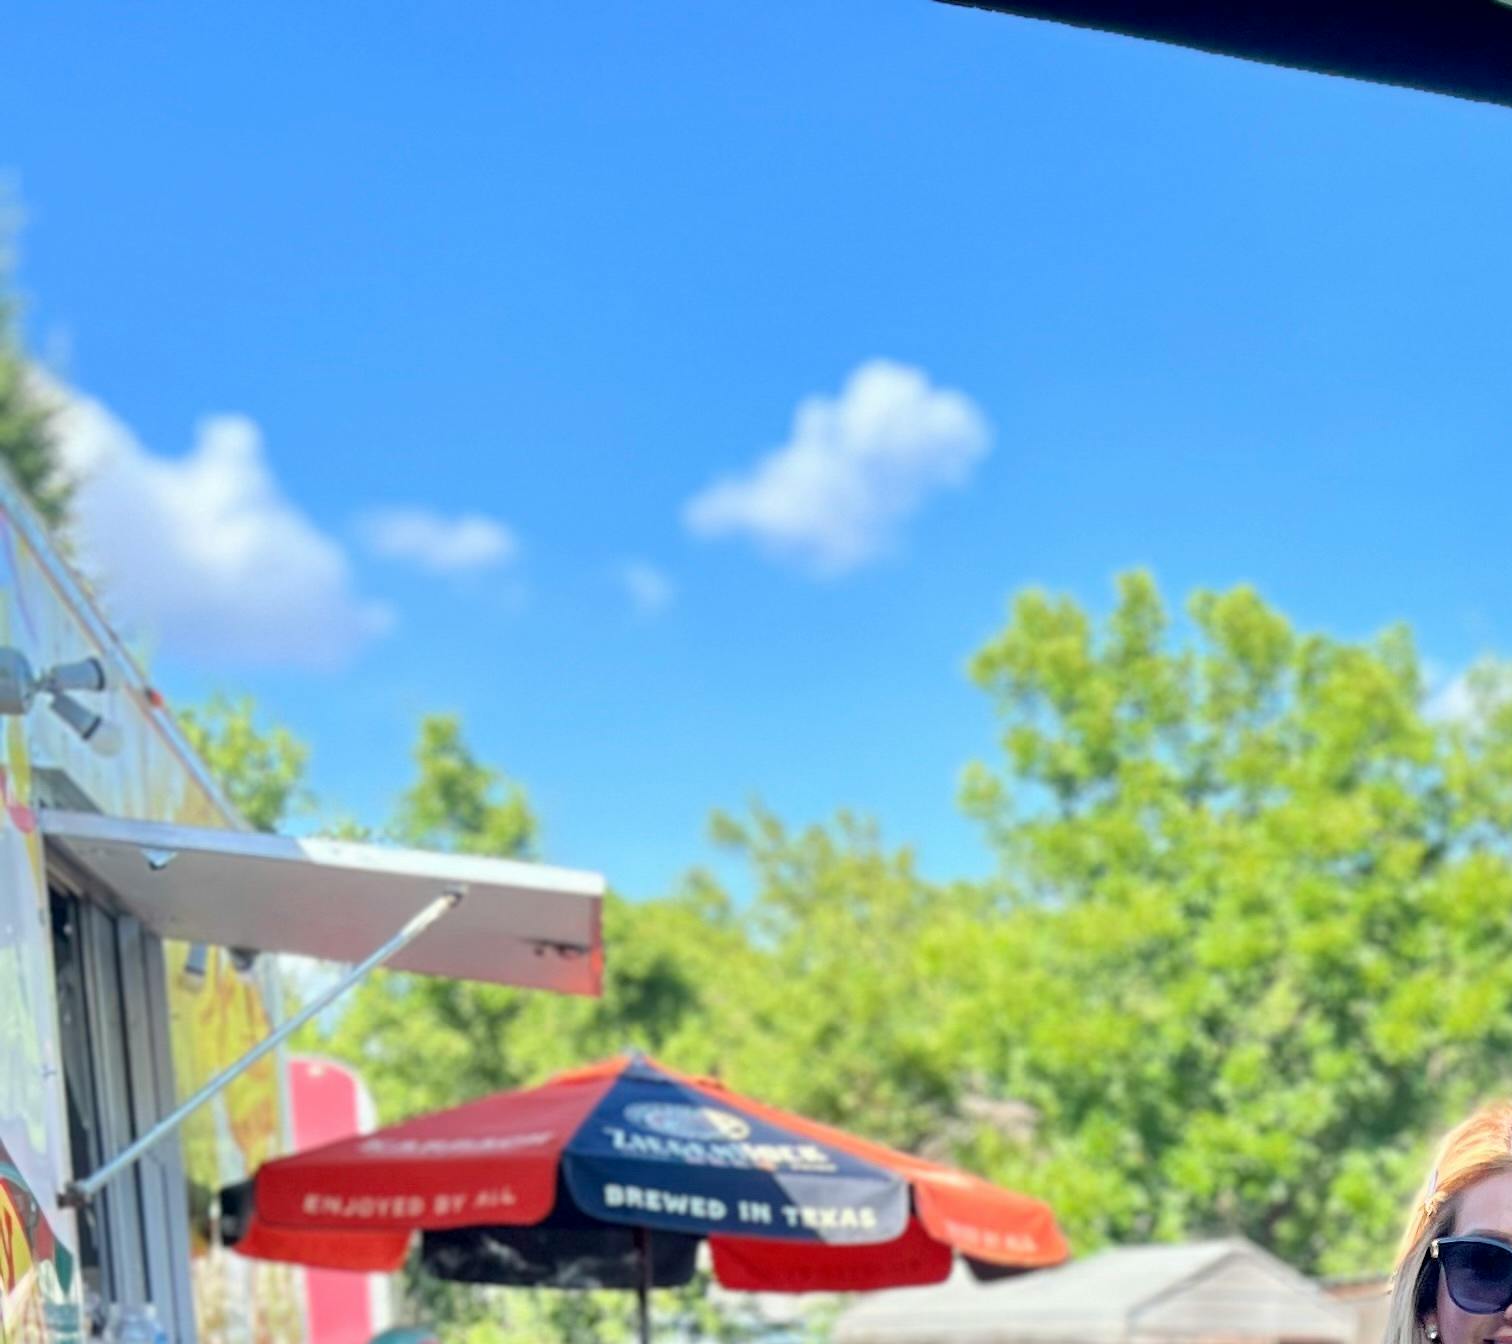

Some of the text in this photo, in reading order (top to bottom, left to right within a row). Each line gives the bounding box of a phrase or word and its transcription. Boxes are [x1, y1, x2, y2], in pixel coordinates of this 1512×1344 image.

[432, 1192, 468, 1217] BY
[603, 1183, 878, 1229] BREWED IN TEXAS
